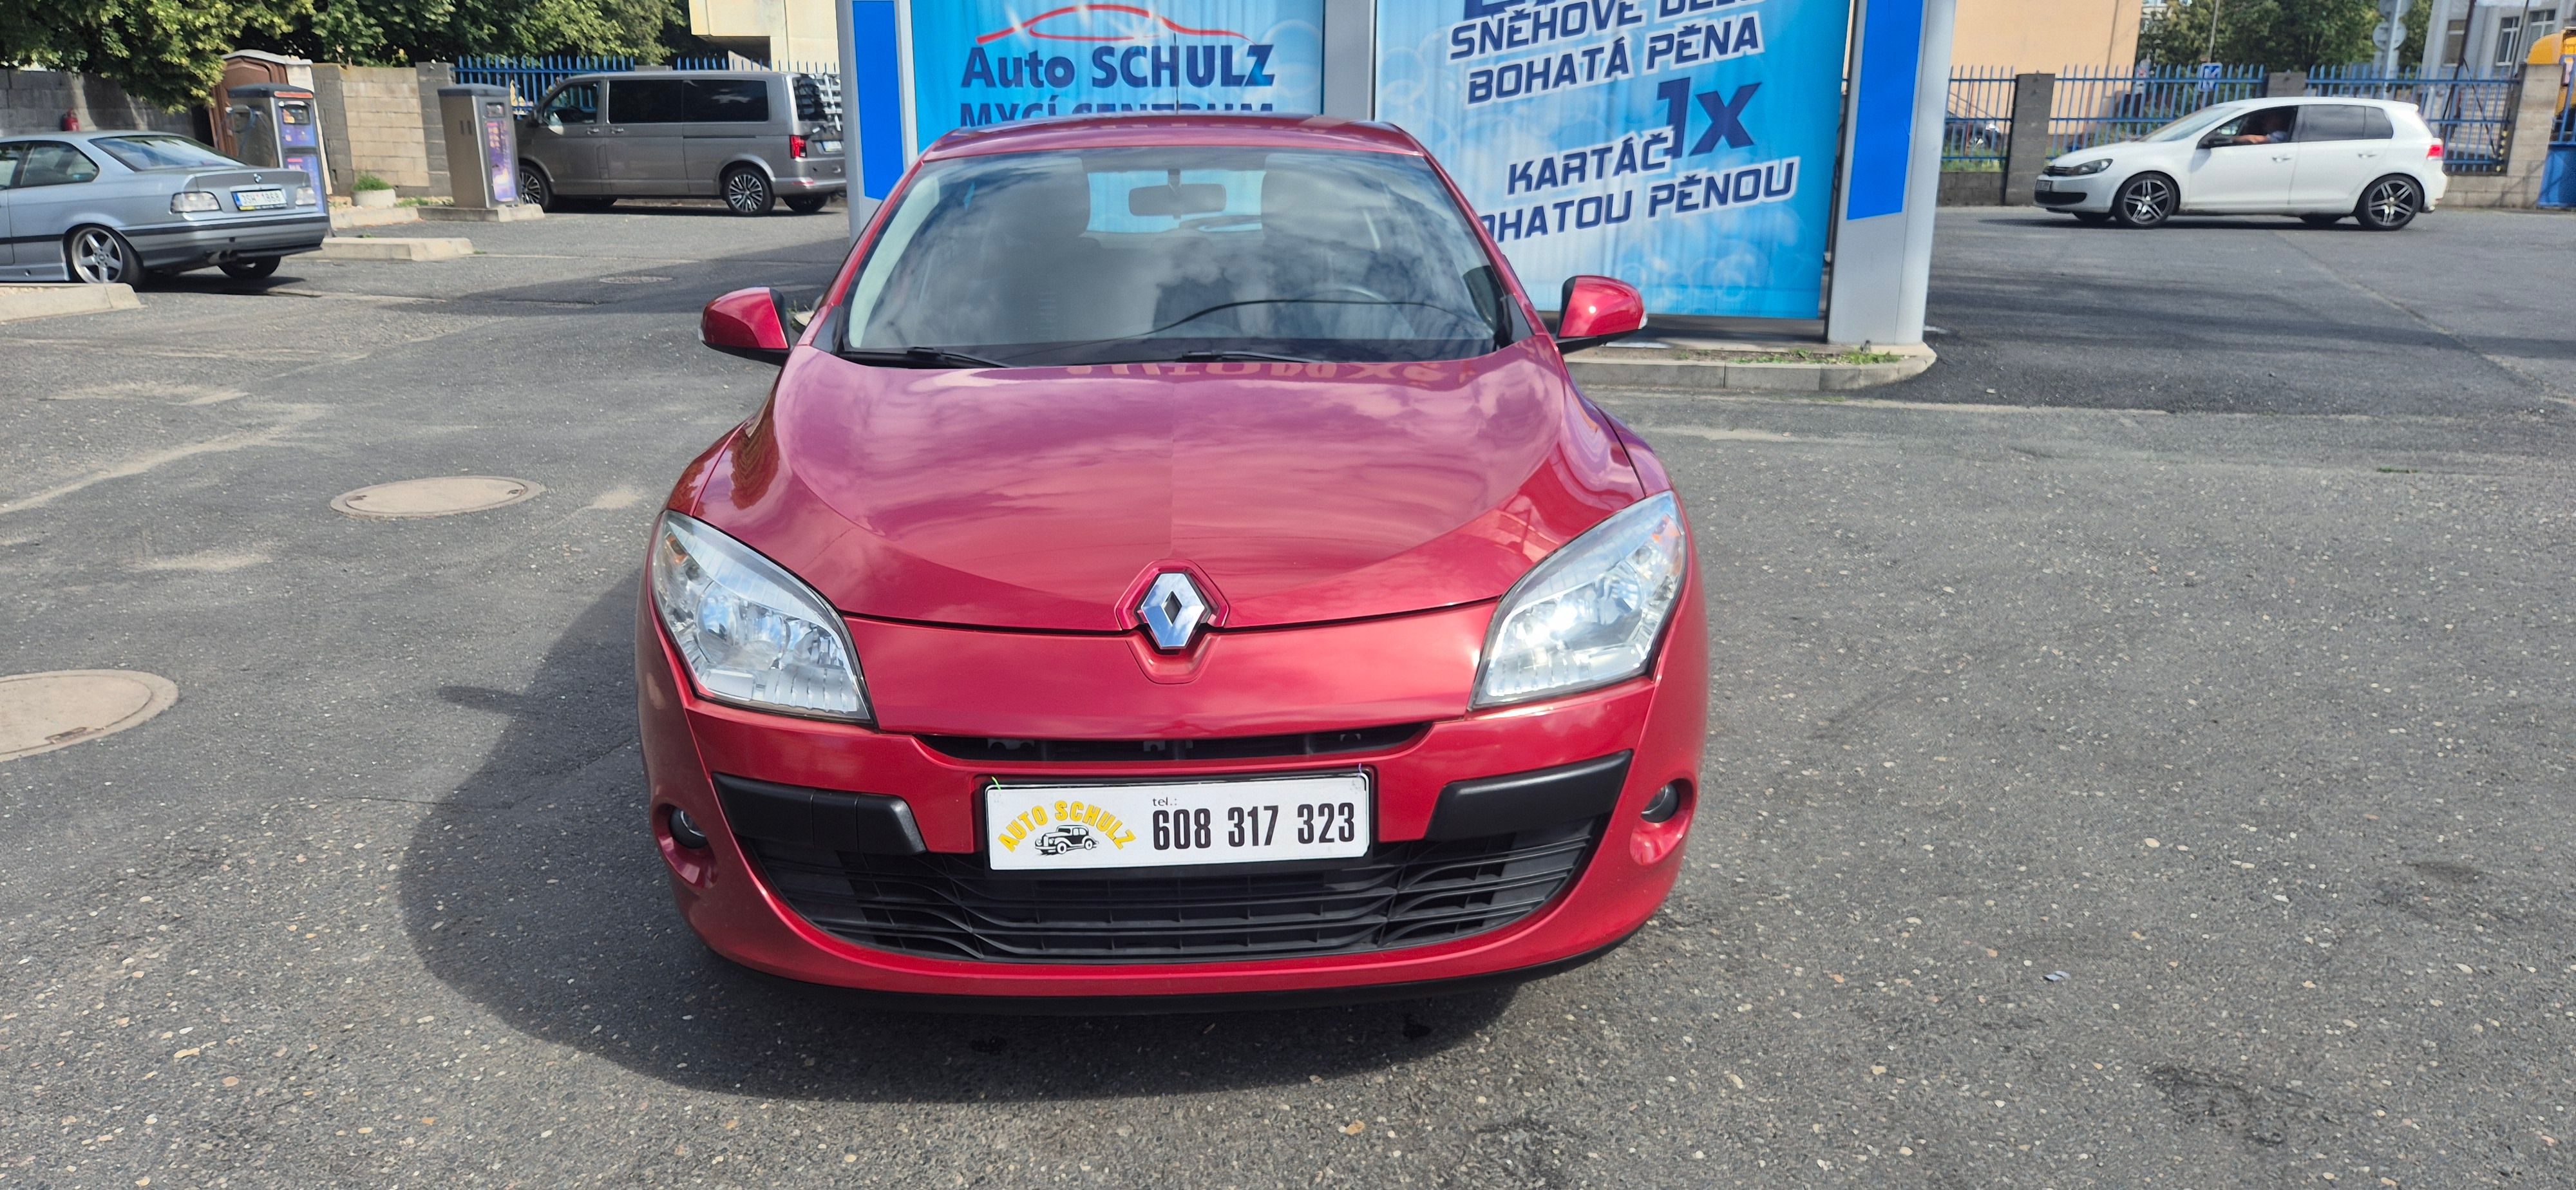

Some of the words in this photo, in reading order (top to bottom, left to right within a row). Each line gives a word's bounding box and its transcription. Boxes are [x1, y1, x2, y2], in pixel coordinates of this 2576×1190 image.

[961, 47, 1075, 88] Auto
[1092, 44, 1275, 88] SCHULZ
[1468, 37, 1631, 104] BOHATÁ
[1646, 16, 1759, 70] PĚNA
[1657, 77, 1762, 159] 1x
[1508, 133, 1669, 194] KARTÁČ
[1479, 190, 1633, 243] OHATOU
[1648, 162, 1795, 218] PĚNOU
[998, 806, 1048, 852] AUTO
[1054, 800, 1136, 850] SCHULZ
[1153, 808, 1211, 850] 608
[1227, 805, 1279, 847] 317
[1297, 802, 1355, 844] 323
